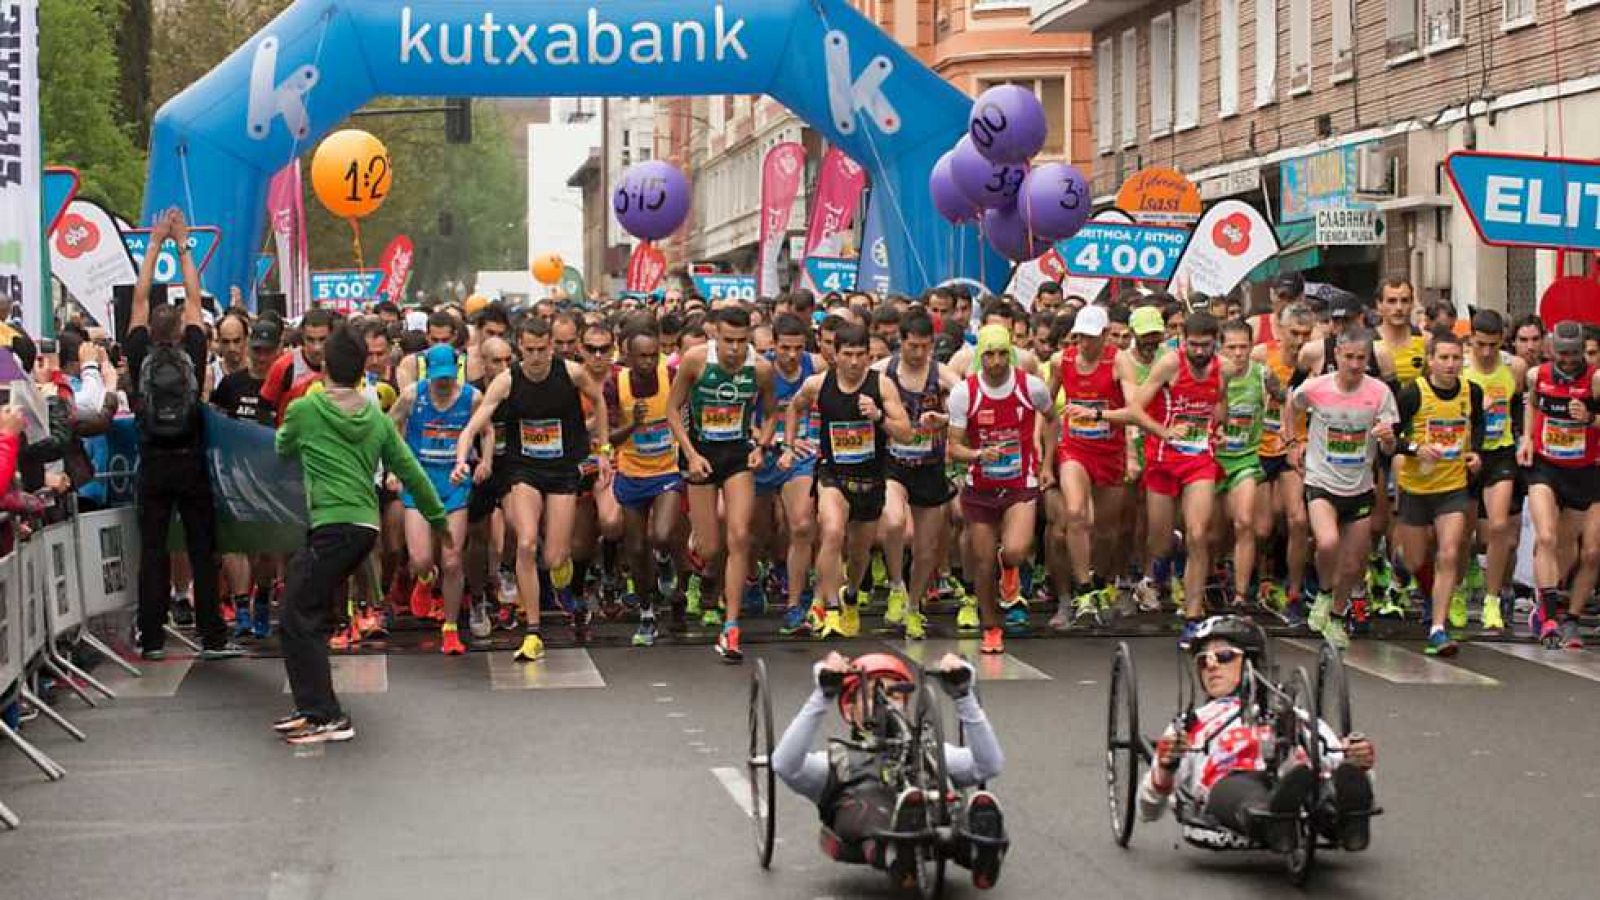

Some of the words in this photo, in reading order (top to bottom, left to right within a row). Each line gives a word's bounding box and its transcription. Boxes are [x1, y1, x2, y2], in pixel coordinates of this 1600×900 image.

[400, 4, 749, 66] kutxabank
[344, 154, 392, 201] 1:2
[1144, 231, 1185, 244] RITMO
